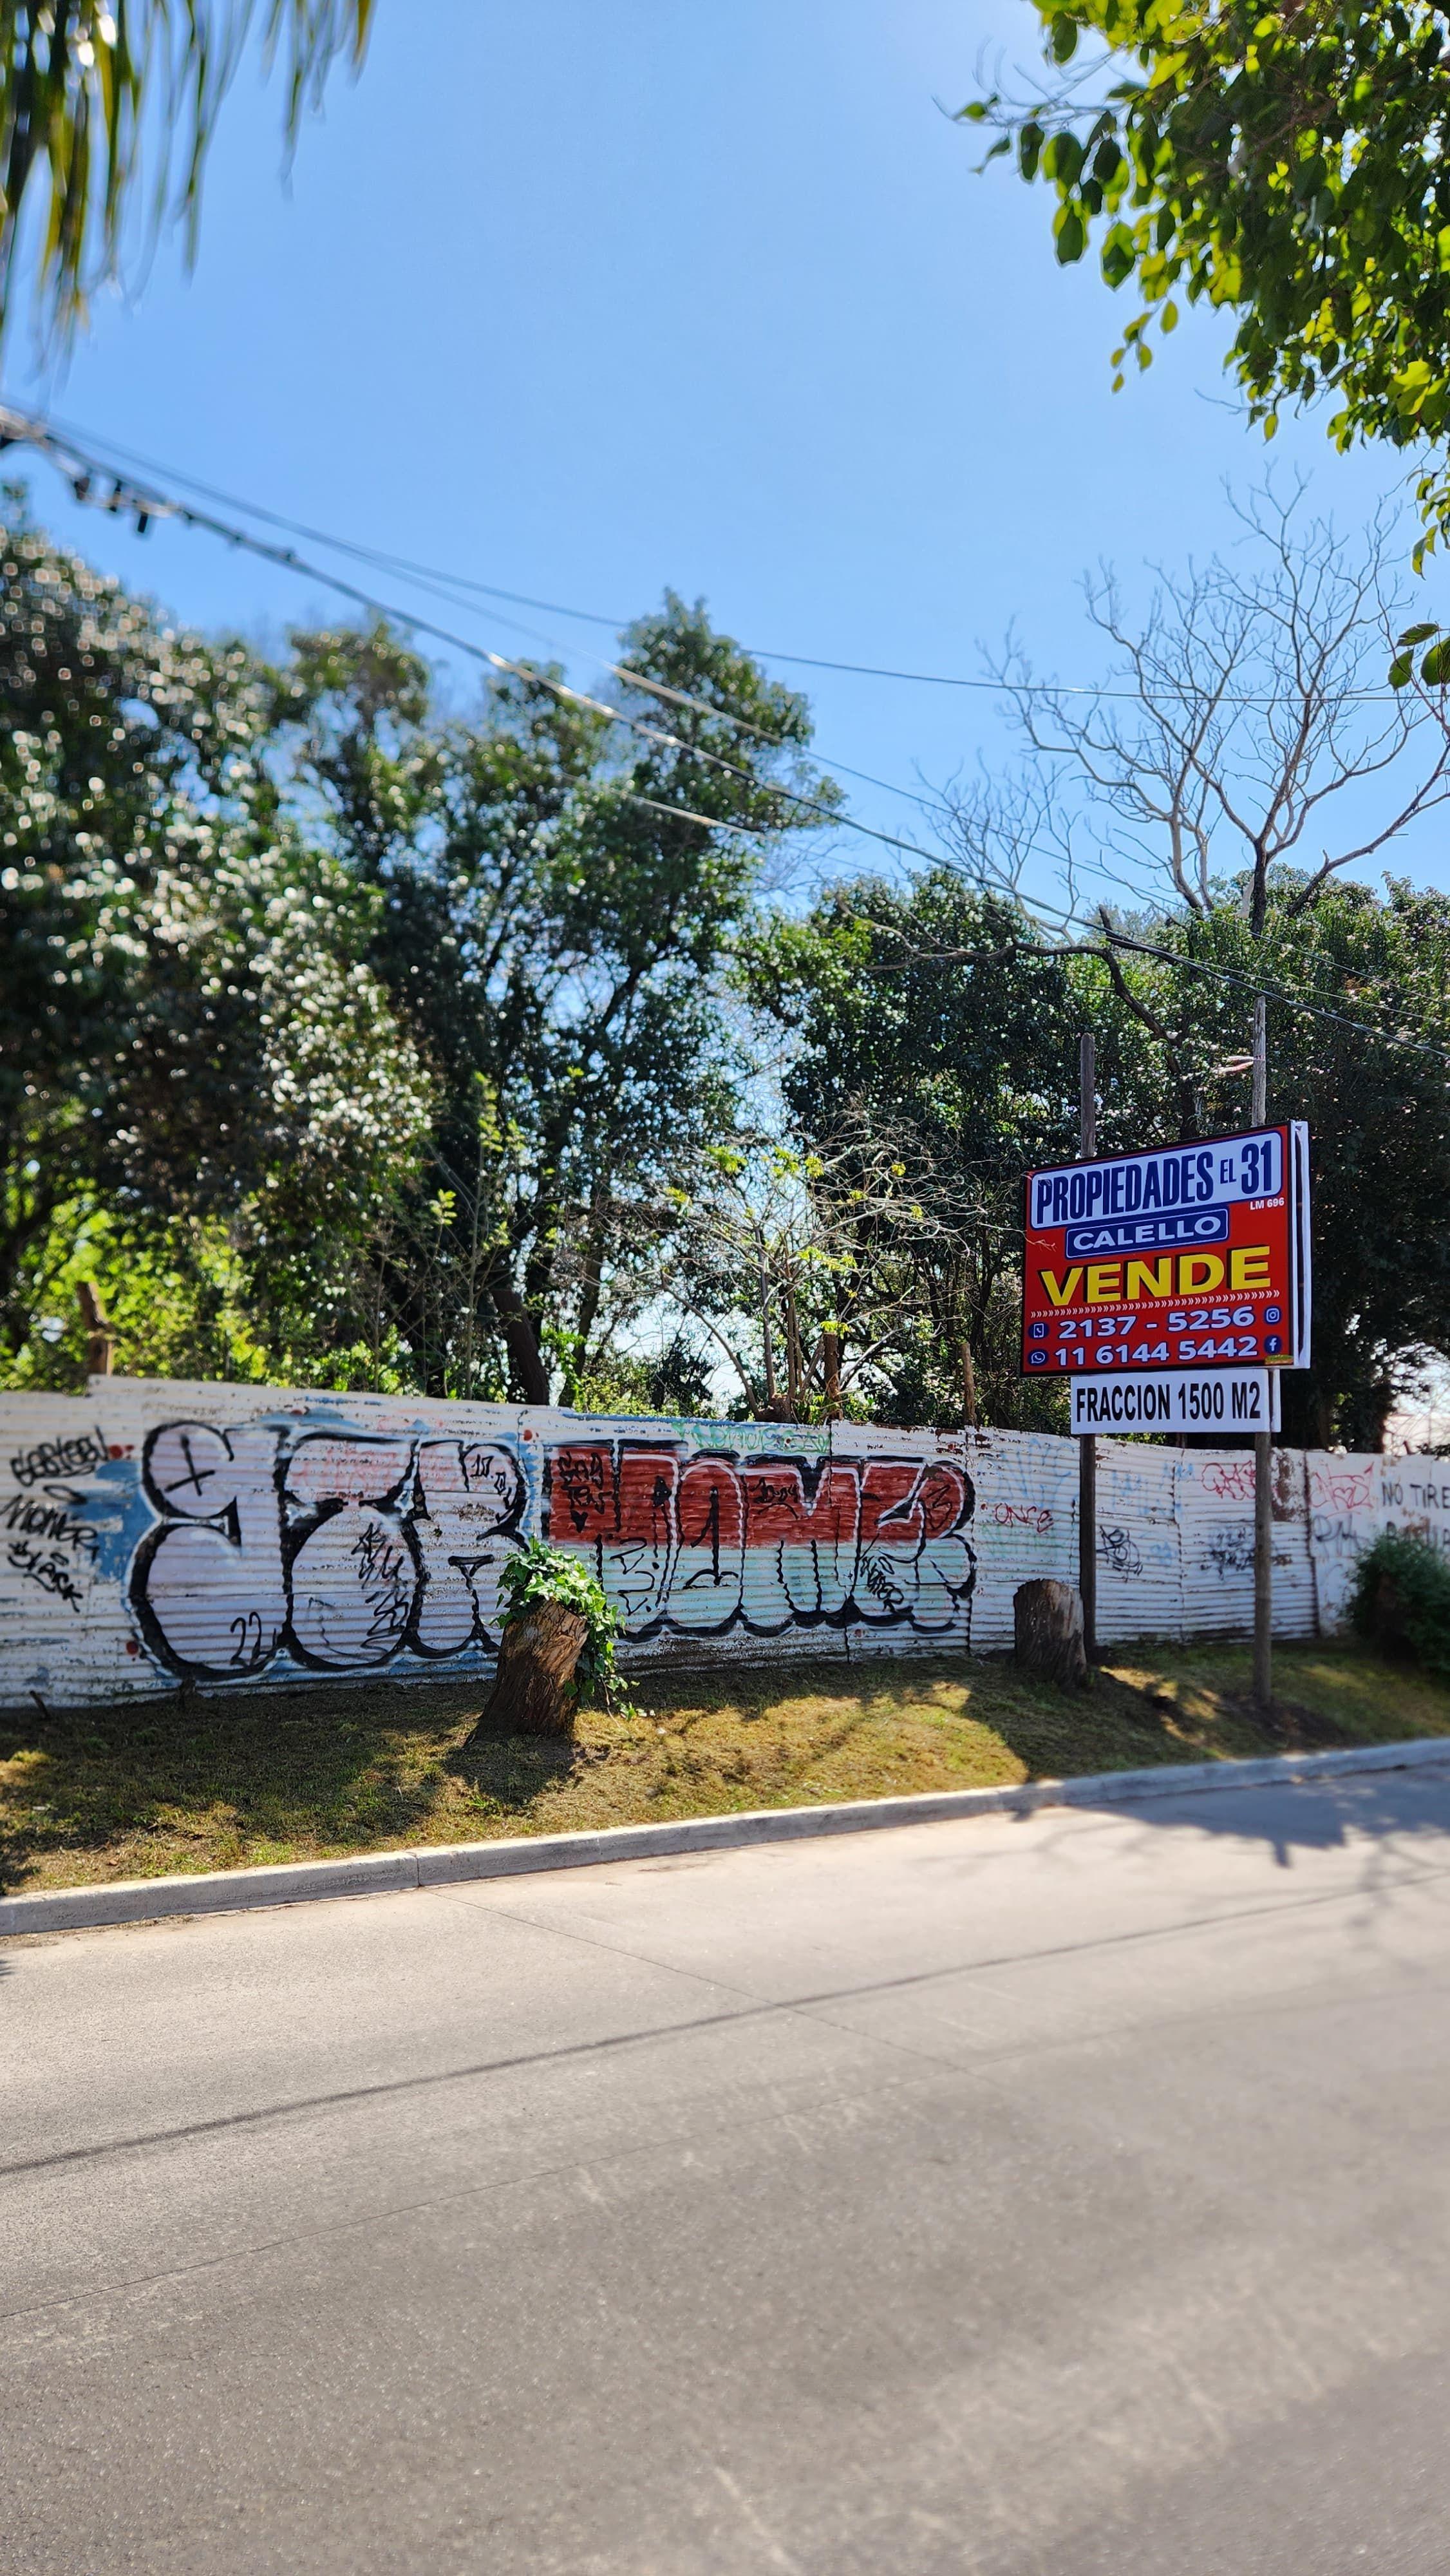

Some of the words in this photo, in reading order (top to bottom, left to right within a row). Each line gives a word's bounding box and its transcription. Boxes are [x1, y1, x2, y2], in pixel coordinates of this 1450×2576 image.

[1037, 1151, 1213, 1224] PROPIEDADES
[1221, 1159, 1236, 1184] EL
[1241, 1141, 1272, 1195] 31
[1250, 1200, 1265, 1210] LM
[1267, 1197, 1285, 1208] 696
[1073, 1216, 1221, 1250] CALELLO
[1040, 1246, 1271, 1306] VENDE
[1059, 1316, 1137, 1340] 2137
[1168, 1306, 1255, 1332] 5256
[1055, 1348, 1085, 1366] 11
[1096, 1341, 1170, 1365] 6144
[1178, 1336, 1258, 1359] 5442
[1076, 1384, 1171, 1422] FRACCION
[1178, 1382, 1224, 1419] 1500
[1232, 1381, 1261, 1419] M2
[1382, 1482, 1404, 1507] NO
